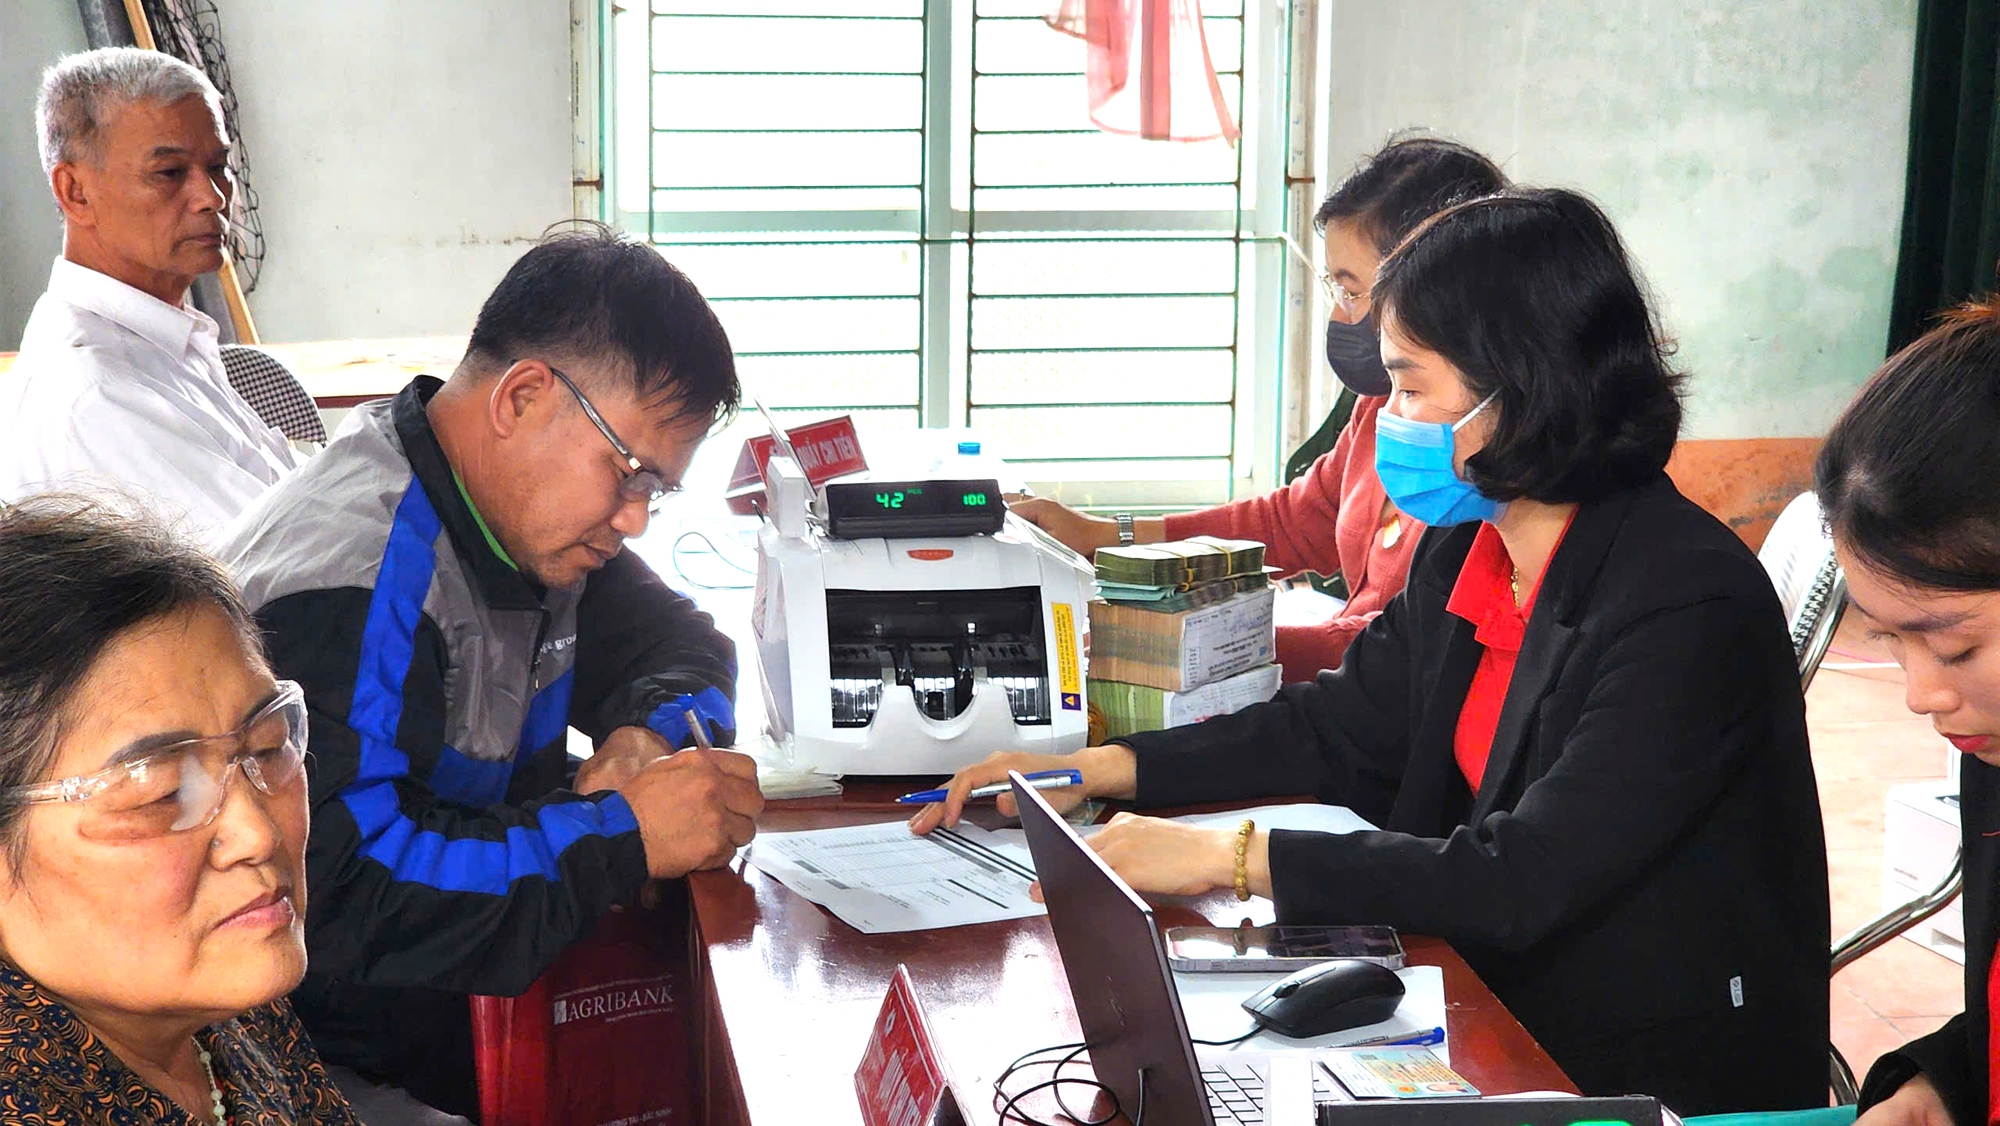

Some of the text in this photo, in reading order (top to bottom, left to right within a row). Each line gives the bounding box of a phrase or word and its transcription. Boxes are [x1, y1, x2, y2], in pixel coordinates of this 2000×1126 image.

[876, 492, 904, 508] 42
[963, 493, 986, 506] 100
[568, 984, 674, 1022] AGRIBANK
